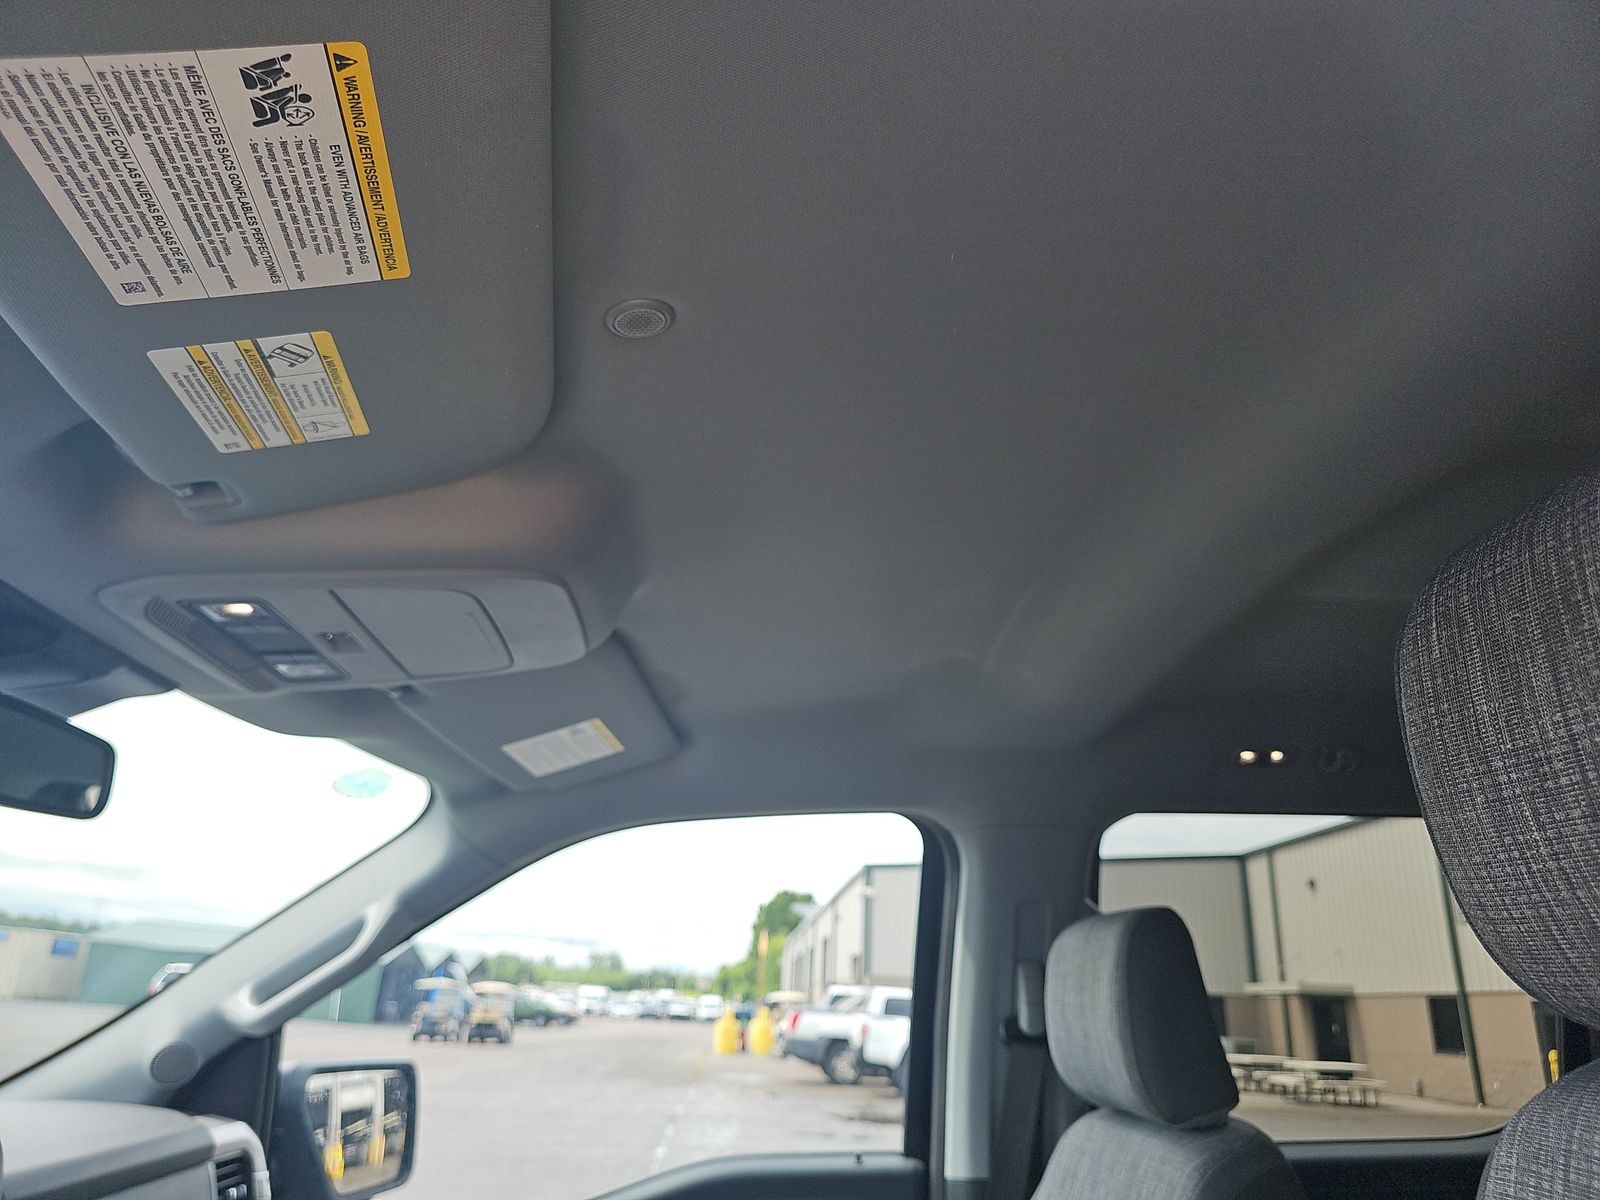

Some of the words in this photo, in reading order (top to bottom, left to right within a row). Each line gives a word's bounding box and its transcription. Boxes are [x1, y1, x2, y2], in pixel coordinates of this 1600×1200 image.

[182, 65, 206, 95] MÊME
[79, 84, 119, 137] INCLUSIVE
[196, 97, 217, 124] AVEC
[342, 75, 366, 128] WARNING
[208, 126, 226, 145] DES
[109, 139, 131, 159] CON
[216, 147, 236, 171] SACS
[328, 144, 345, 167] EVEN
[122, 161, 142, 178] LAS
[335, 169, 350, 189] WITH
[132, 181, 160, 213] NUEVAS
[227, 173, 258, 226] GONFLABLES
[341, 190, 361, 231] ADVANCED
[151, 215, 177, 245] BOLSAS
[352, 232, 364, 244] AIR
[169, 246, 183, 256] DE
[250, 227, 284, 284] PERFECTIONNÉS
[355, 245, 369, 264] BAGS
[175, 257, 193, 274] AIRE
